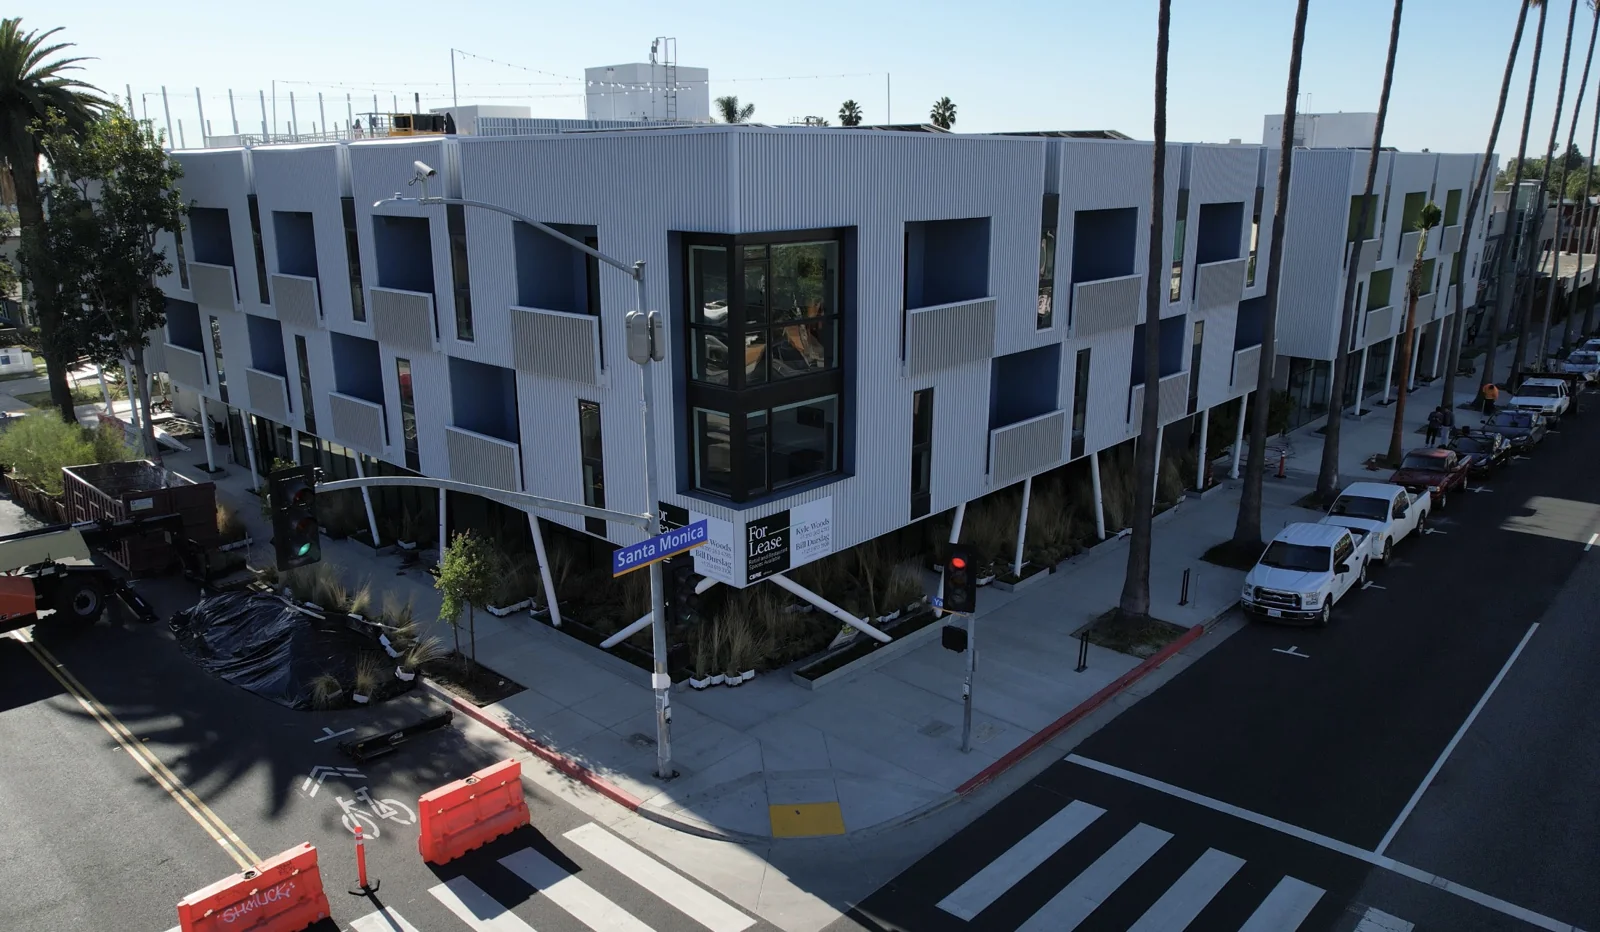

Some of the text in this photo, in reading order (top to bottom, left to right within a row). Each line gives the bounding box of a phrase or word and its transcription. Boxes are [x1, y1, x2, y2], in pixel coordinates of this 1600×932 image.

[810, 518, 830, 530] Woods
[748, 525, 768, 542] For
[617, 543, 656, 568] Santa
[659, 526, 704, 552] Monica
[709, 538, 732, 552] Woods
[749, 536, 782, 558] Lease
[695, 549, 706, 560] Bill
